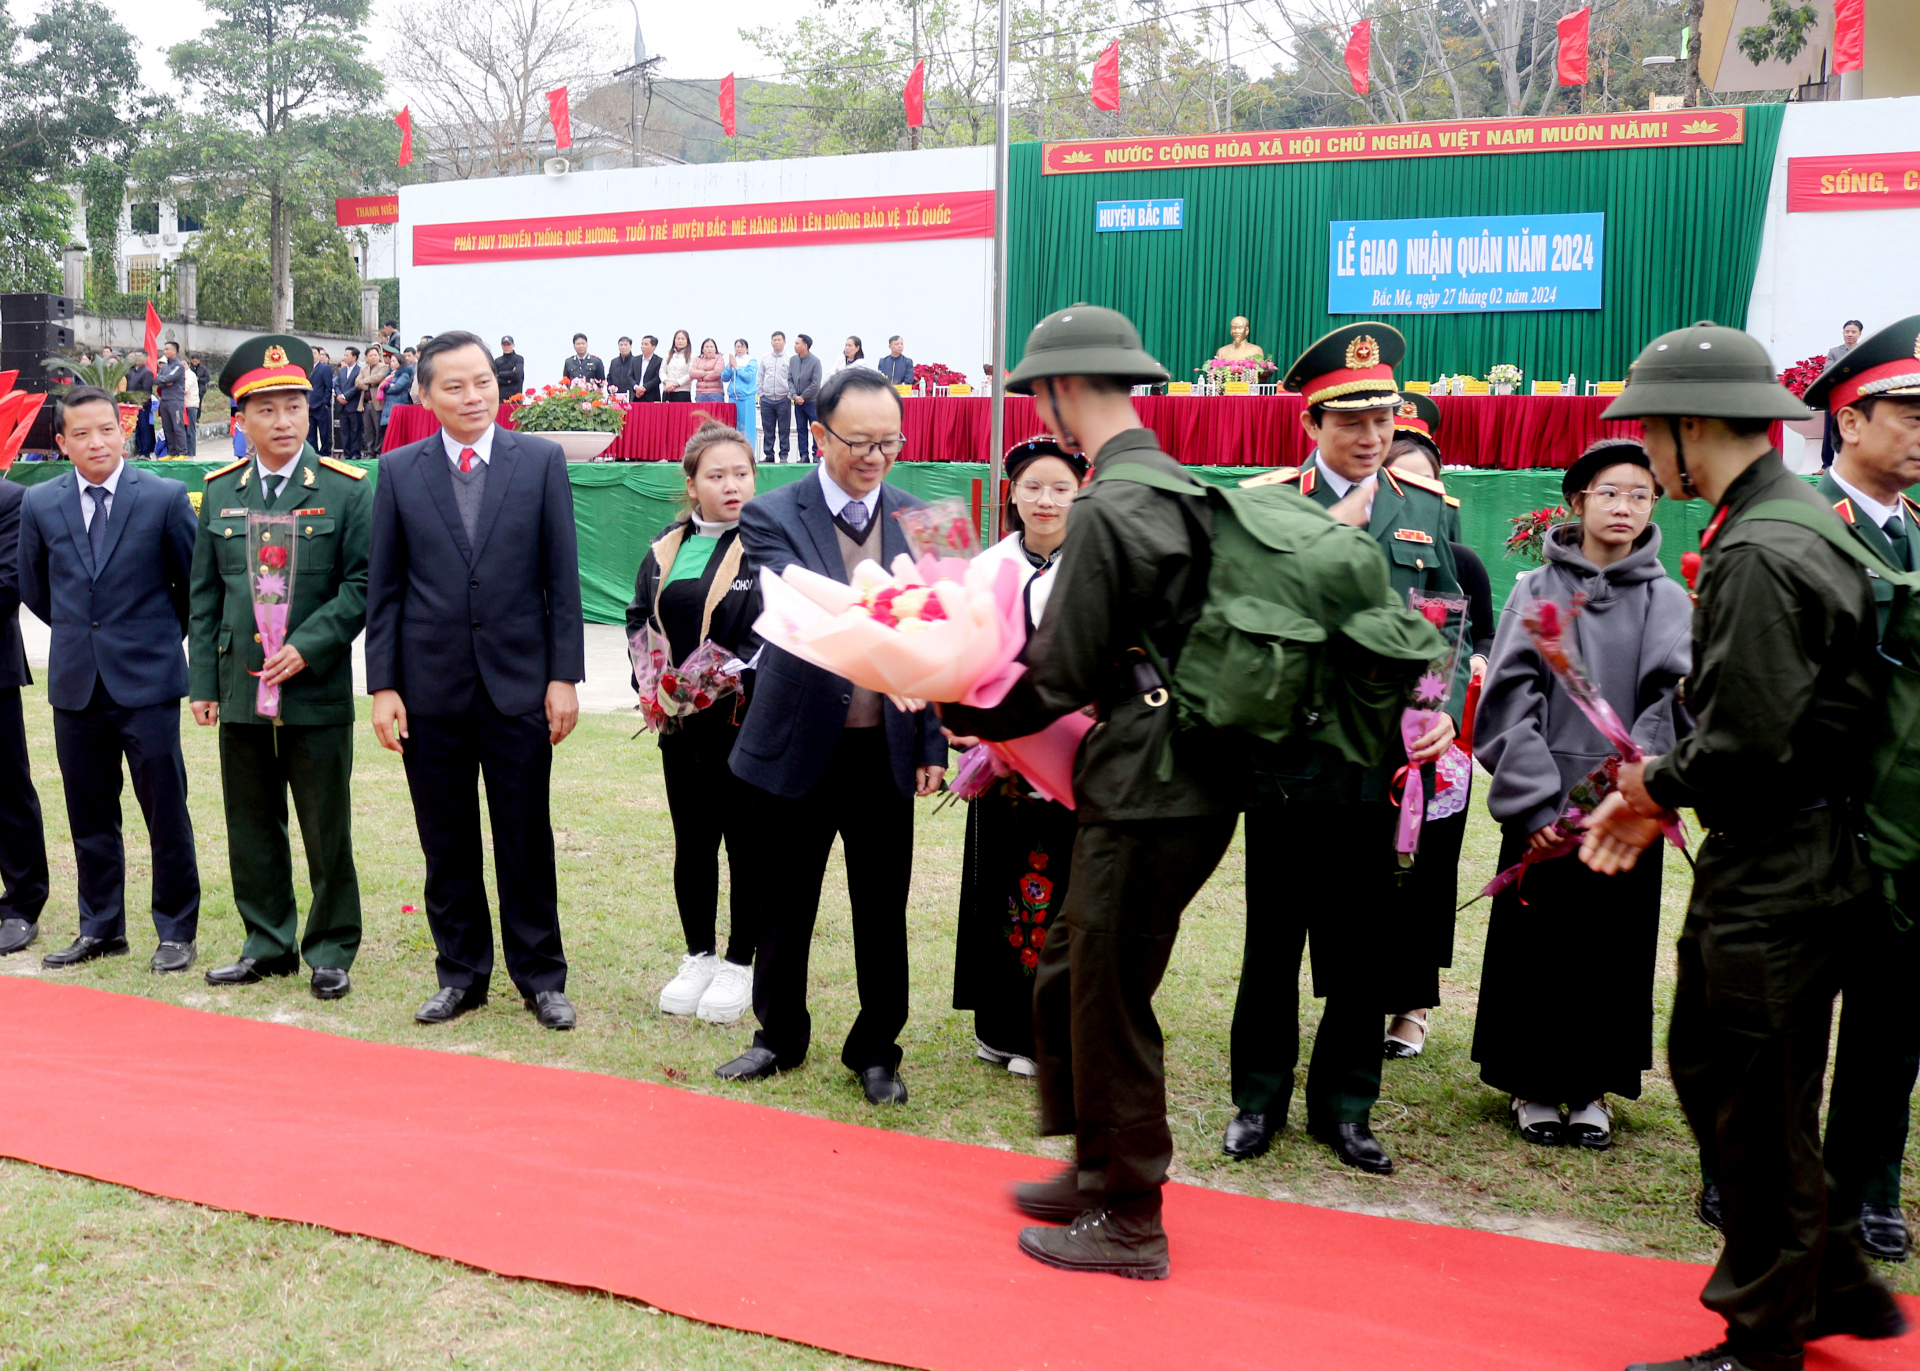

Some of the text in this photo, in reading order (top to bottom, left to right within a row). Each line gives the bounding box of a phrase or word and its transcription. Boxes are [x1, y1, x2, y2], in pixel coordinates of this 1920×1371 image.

[1104, 120, 1668, 164] NƯỚC CỘNG HÒA XÃ HỘI CHỦ NGHĨA VIỆT NAM MUÔN NĂM!
[1820, 167, 1920, 195] SỐNG, C
[355, 205, 380, 218] THANH
[454, 233, 477, 252] PHÁT
[478, 235, 496, 250] HUY
[533, 226, 564, 247] THỐNG
[565, 226, 583, 247] QUÊ
[585, 226, 619, 245] HƯƠNG,
[625, 218, 646, 242] TUỔI
[650, 217, 668, 241] TRẺ
[672, 218, 704, 242] HUYỆN
[706, 214, 726, 238] BẮC
[731, 215, 747, 236] MÊ
[749, 215, 778, 235] HĂNG
[780, 212, 797, 233] HÁI
[802, 211, 822, 232] LÊN
[824, 209, 860, 231] ĐƯỜNG
[863, 205, 885, 229] BẢO
[887, 206, 901, 230] VỆ
[905, 201, 920, 226] TỔ
[922, 203, 951, 227] QUỐC
[1099, 200, 1180, 231] HUYỆN BẮC MÊ
[1337, 226, 1594, 281] LỄ GIAO NHẬN QUÂN NĂM 2024
[1371, 286, 1557, 309] Bắc Mê, ngày 27 tháng 02 năm 2024
